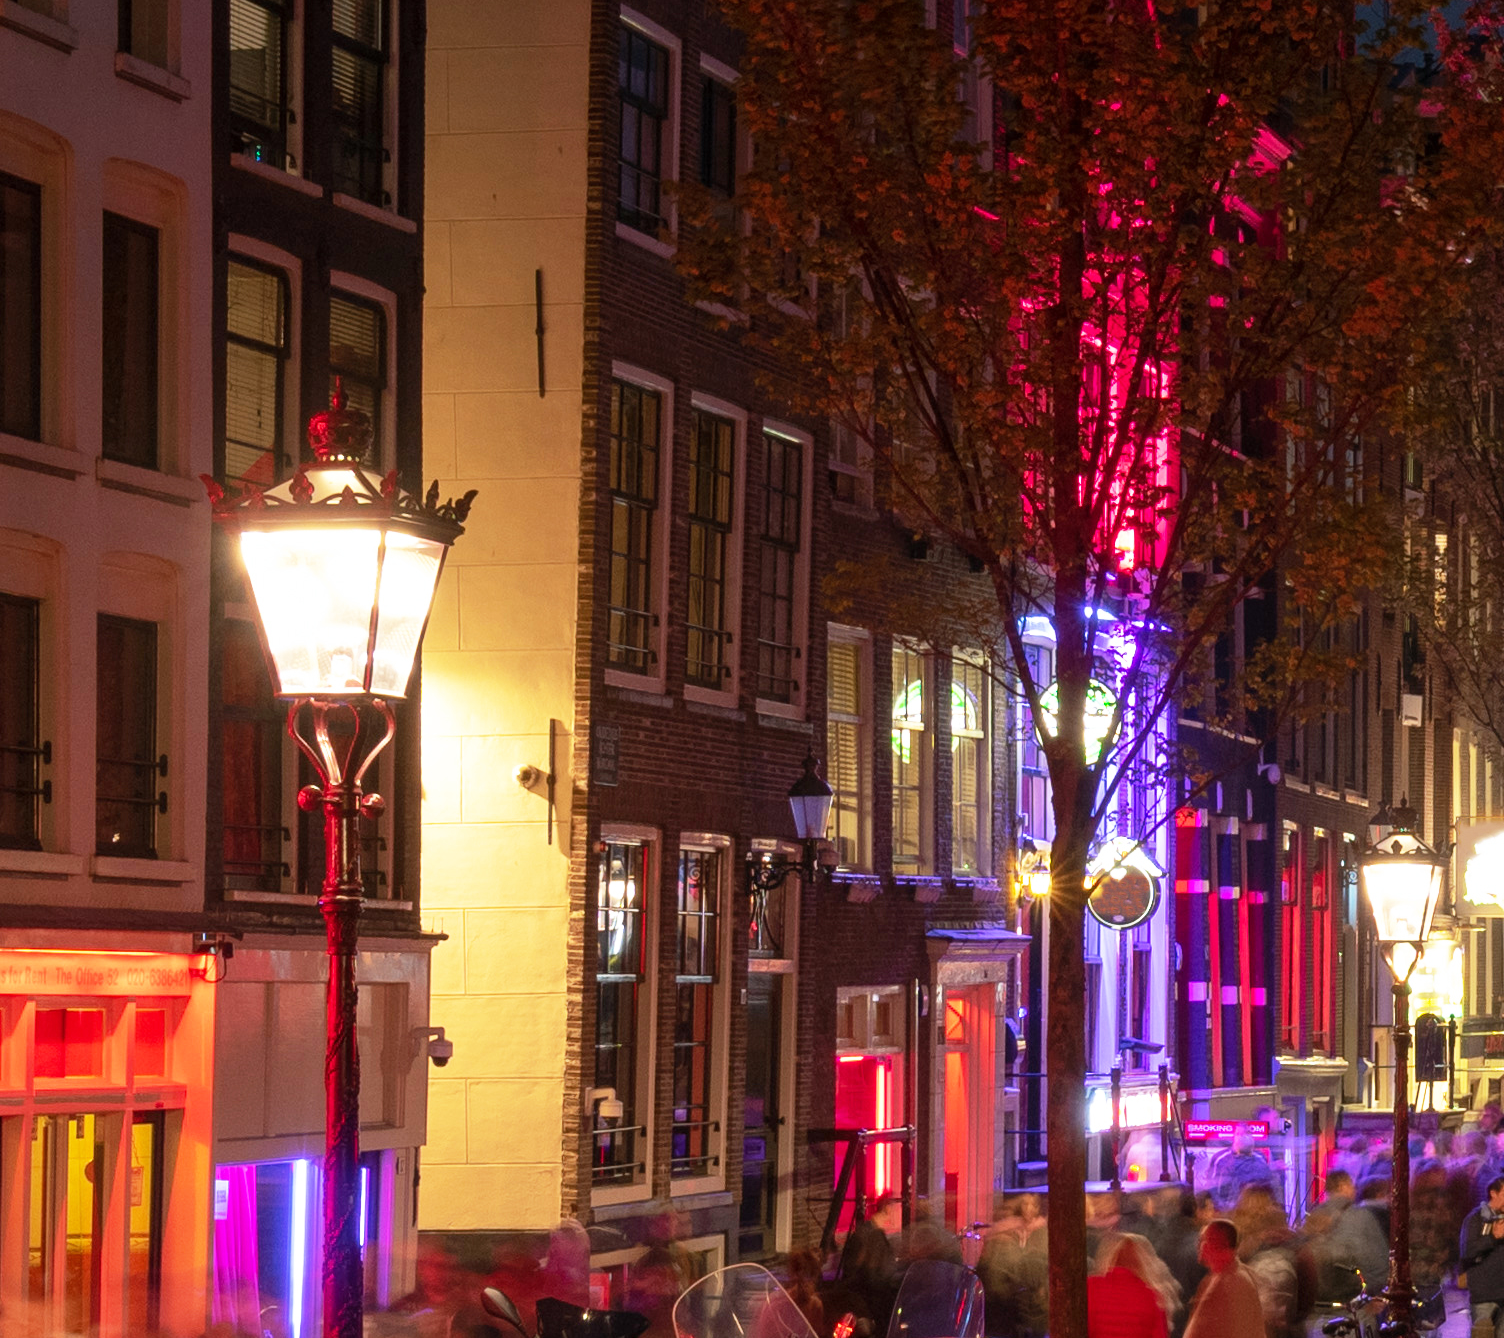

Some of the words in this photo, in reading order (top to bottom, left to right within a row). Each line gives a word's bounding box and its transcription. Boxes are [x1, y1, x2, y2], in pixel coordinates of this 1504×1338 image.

[24, 967, 47, 985] Rent
[56, 967, 73, 984] The
[76, 968, 103, 986] Office
[106, 969, 119, 986] 52
[1187, 1124, 1234, 1132] SMOKING
